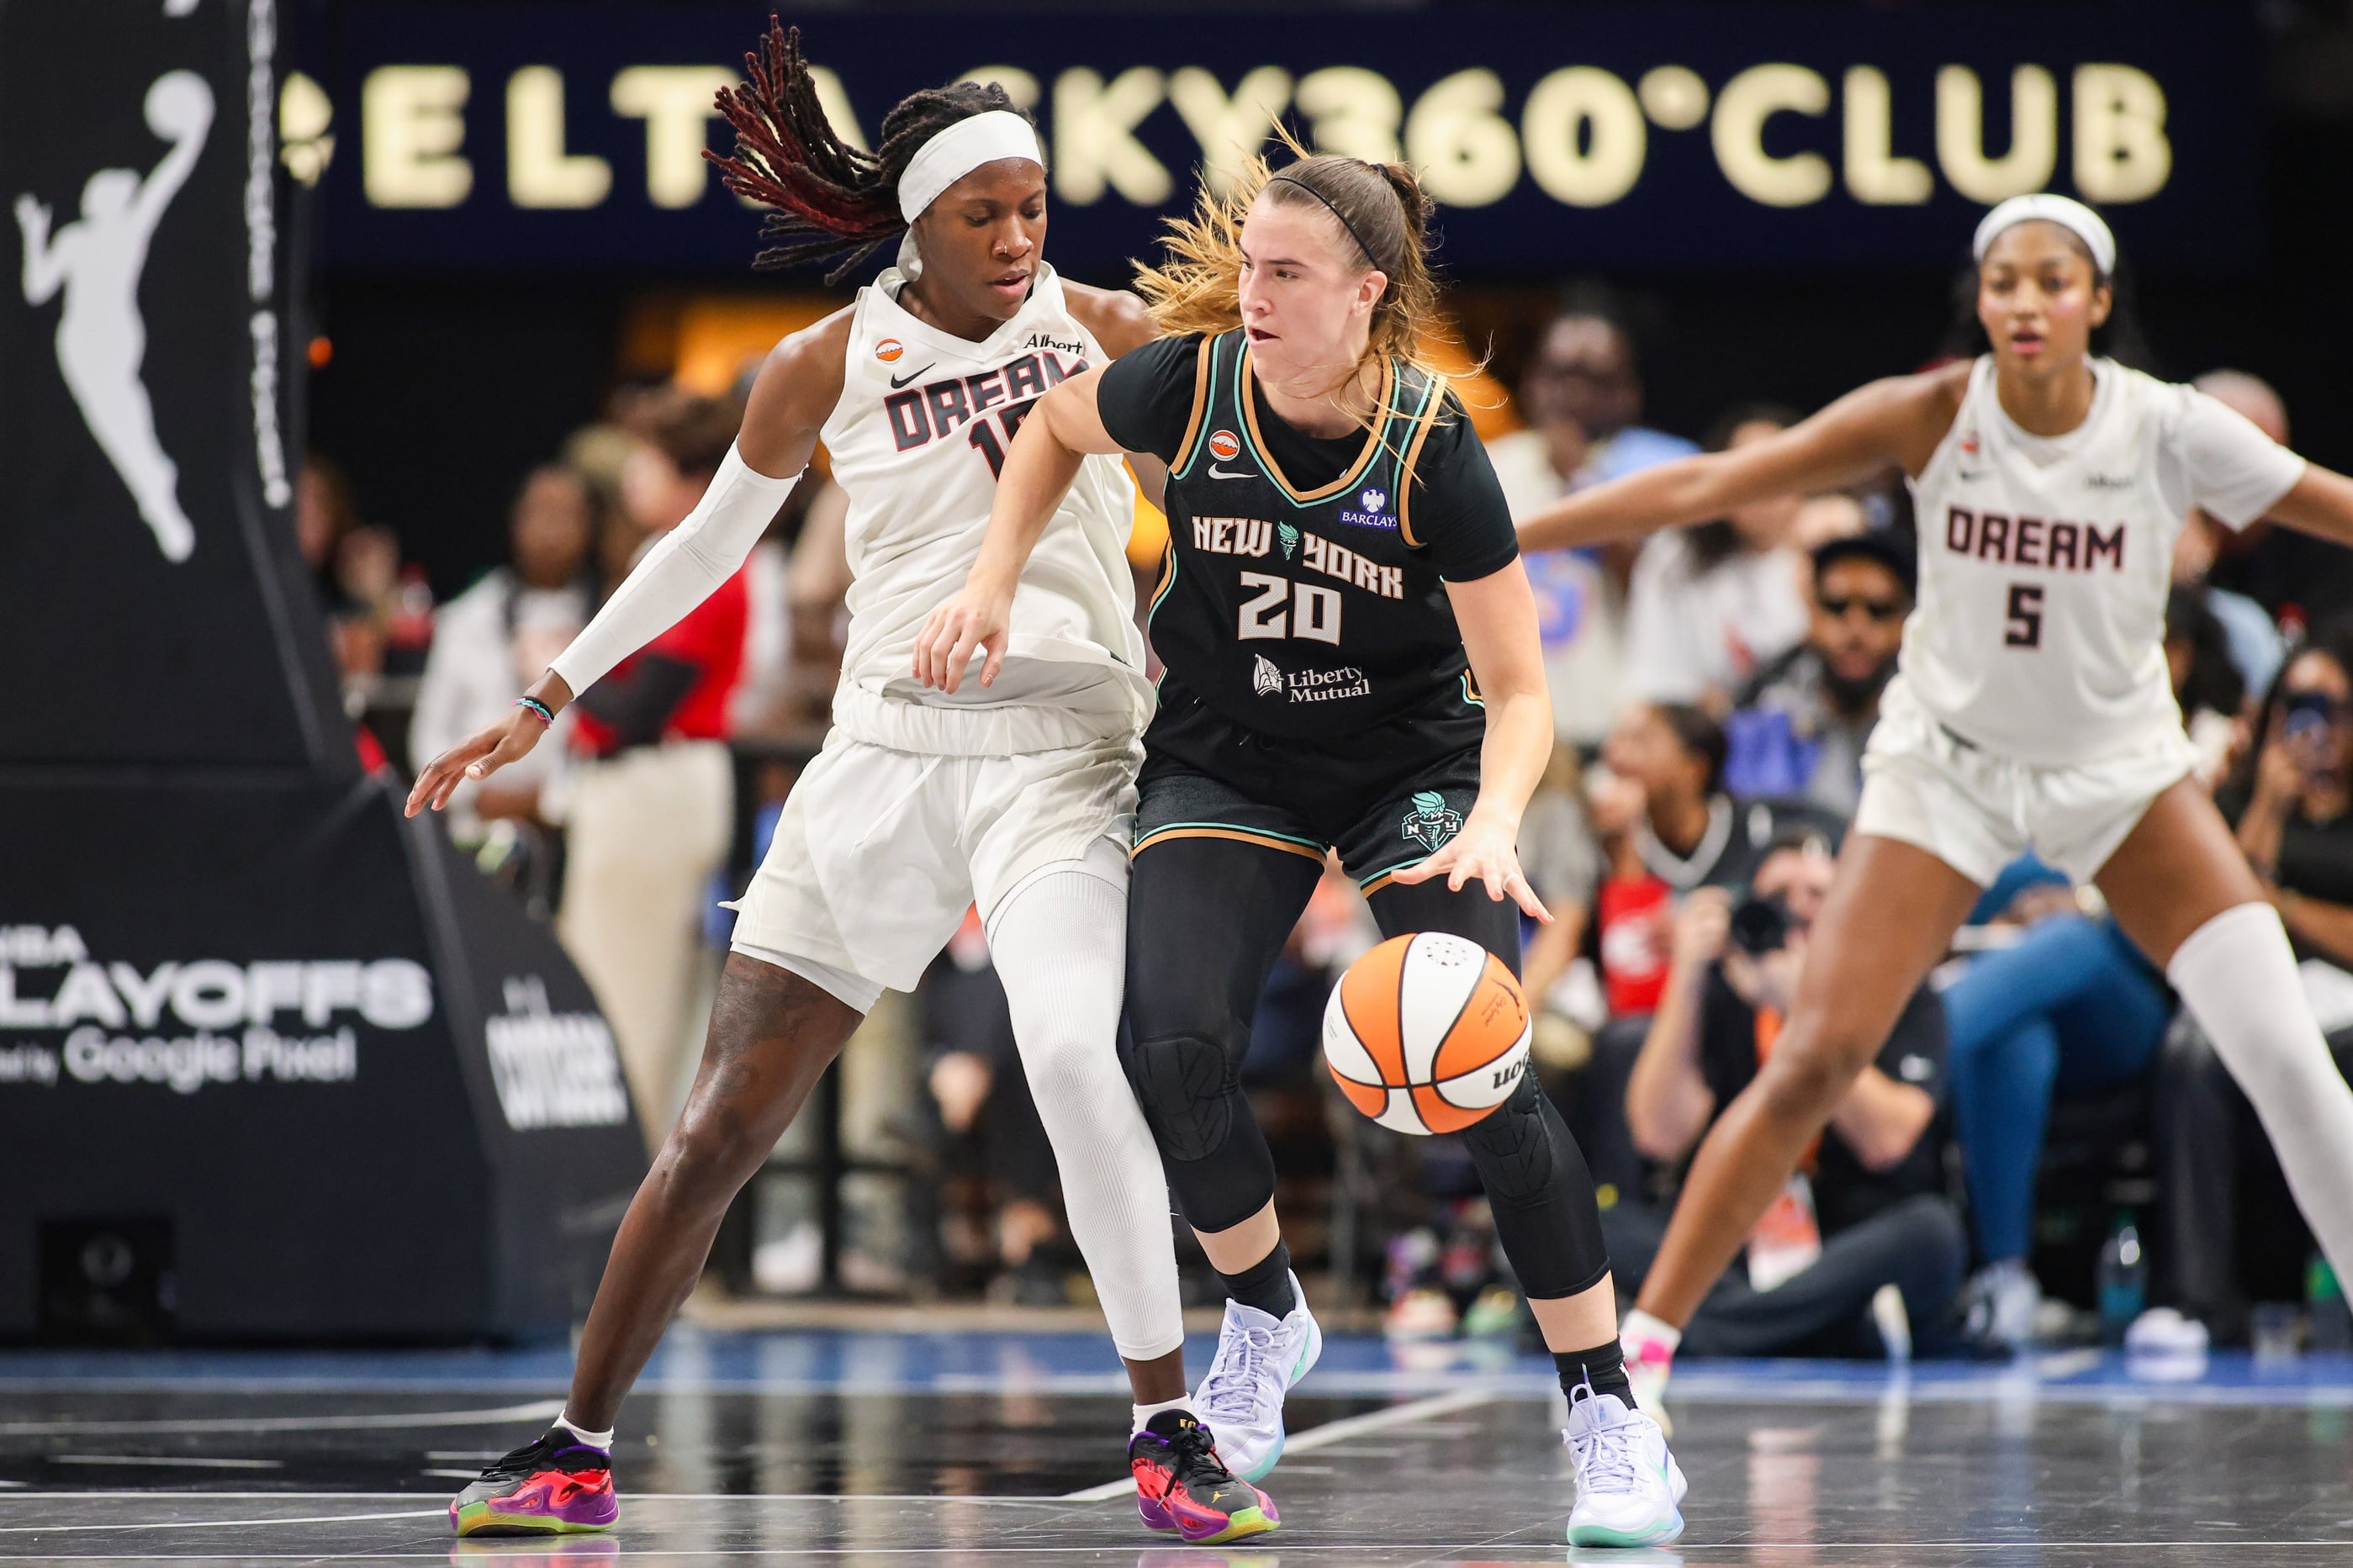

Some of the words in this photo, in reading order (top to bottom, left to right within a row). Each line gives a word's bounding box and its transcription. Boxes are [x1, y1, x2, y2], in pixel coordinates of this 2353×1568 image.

[1023, 333, 1082, 354] Albert
[968, 398, 1038, 483] 1
[1342, 511, 1397, 527] BARCLAYS
[1947, 504, 2126, 573] DREAM
[1192, 516, 1272, 557] NEW
[1303, 531, 1404, 599] YORK
[1239, 571, 1342, 647] 20
[2005, 581, 2045, 649] 5
[1287, 666, 1362, 687] Liberty
[1289, 678, 1372, 703] Mutual
[63, 1026, 240, 1094] Google
[242, 1026, 357, 1082] Pixel
